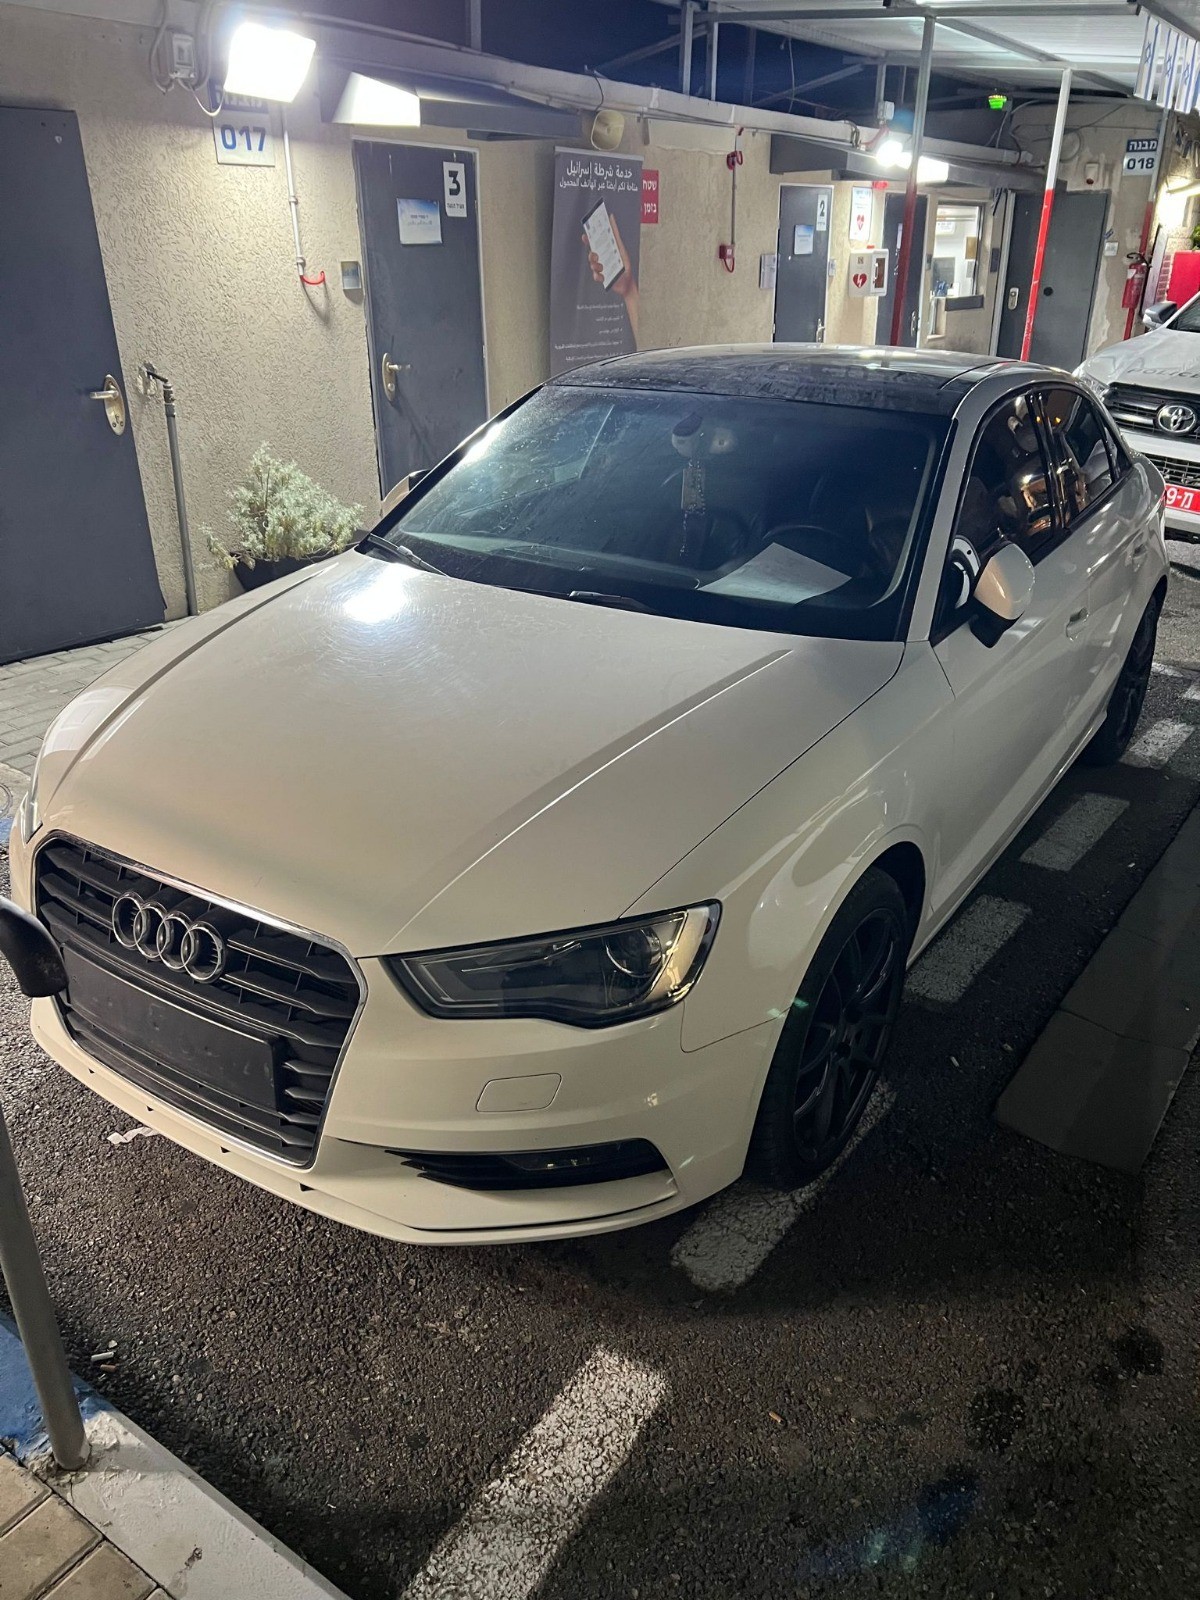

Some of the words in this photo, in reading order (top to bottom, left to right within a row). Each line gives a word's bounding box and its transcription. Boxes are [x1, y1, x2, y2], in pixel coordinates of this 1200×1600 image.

[220, 124, 266, 151] 017
[1129, 140, 1158, 151] מבנה
[594, 162, 614, 180] شرطة
[616, 165, 633, 178] خدمة
[1127, 157, 1155, 170] 018
[448, 170, 461, 196] 3
[819, 200, 825, 217] 2
